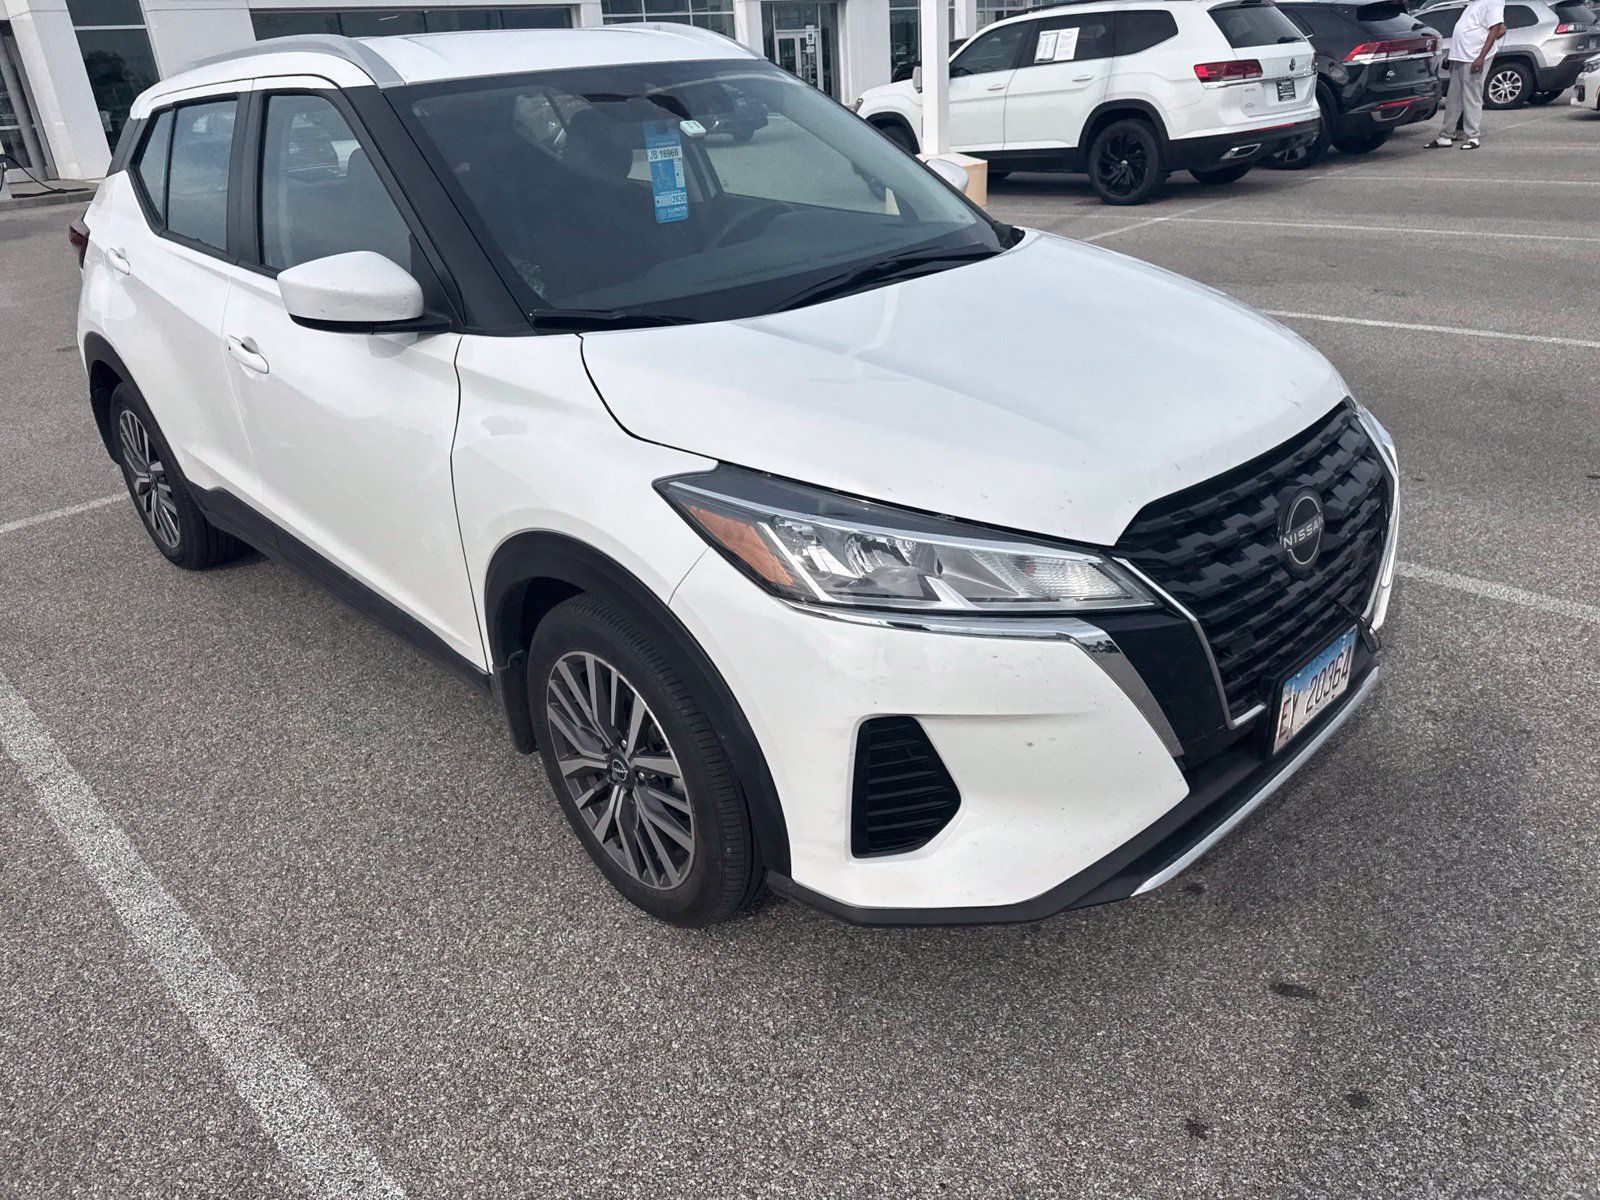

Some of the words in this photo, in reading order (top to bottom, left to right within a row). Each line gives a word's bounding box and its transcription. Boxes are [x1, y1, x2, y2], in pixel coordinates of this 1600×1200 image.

[1283, 513, 1325, 549] NISSAN
[1277, 689, 1301, 741] EY
[1303, 645, 1353, 716] 20364
